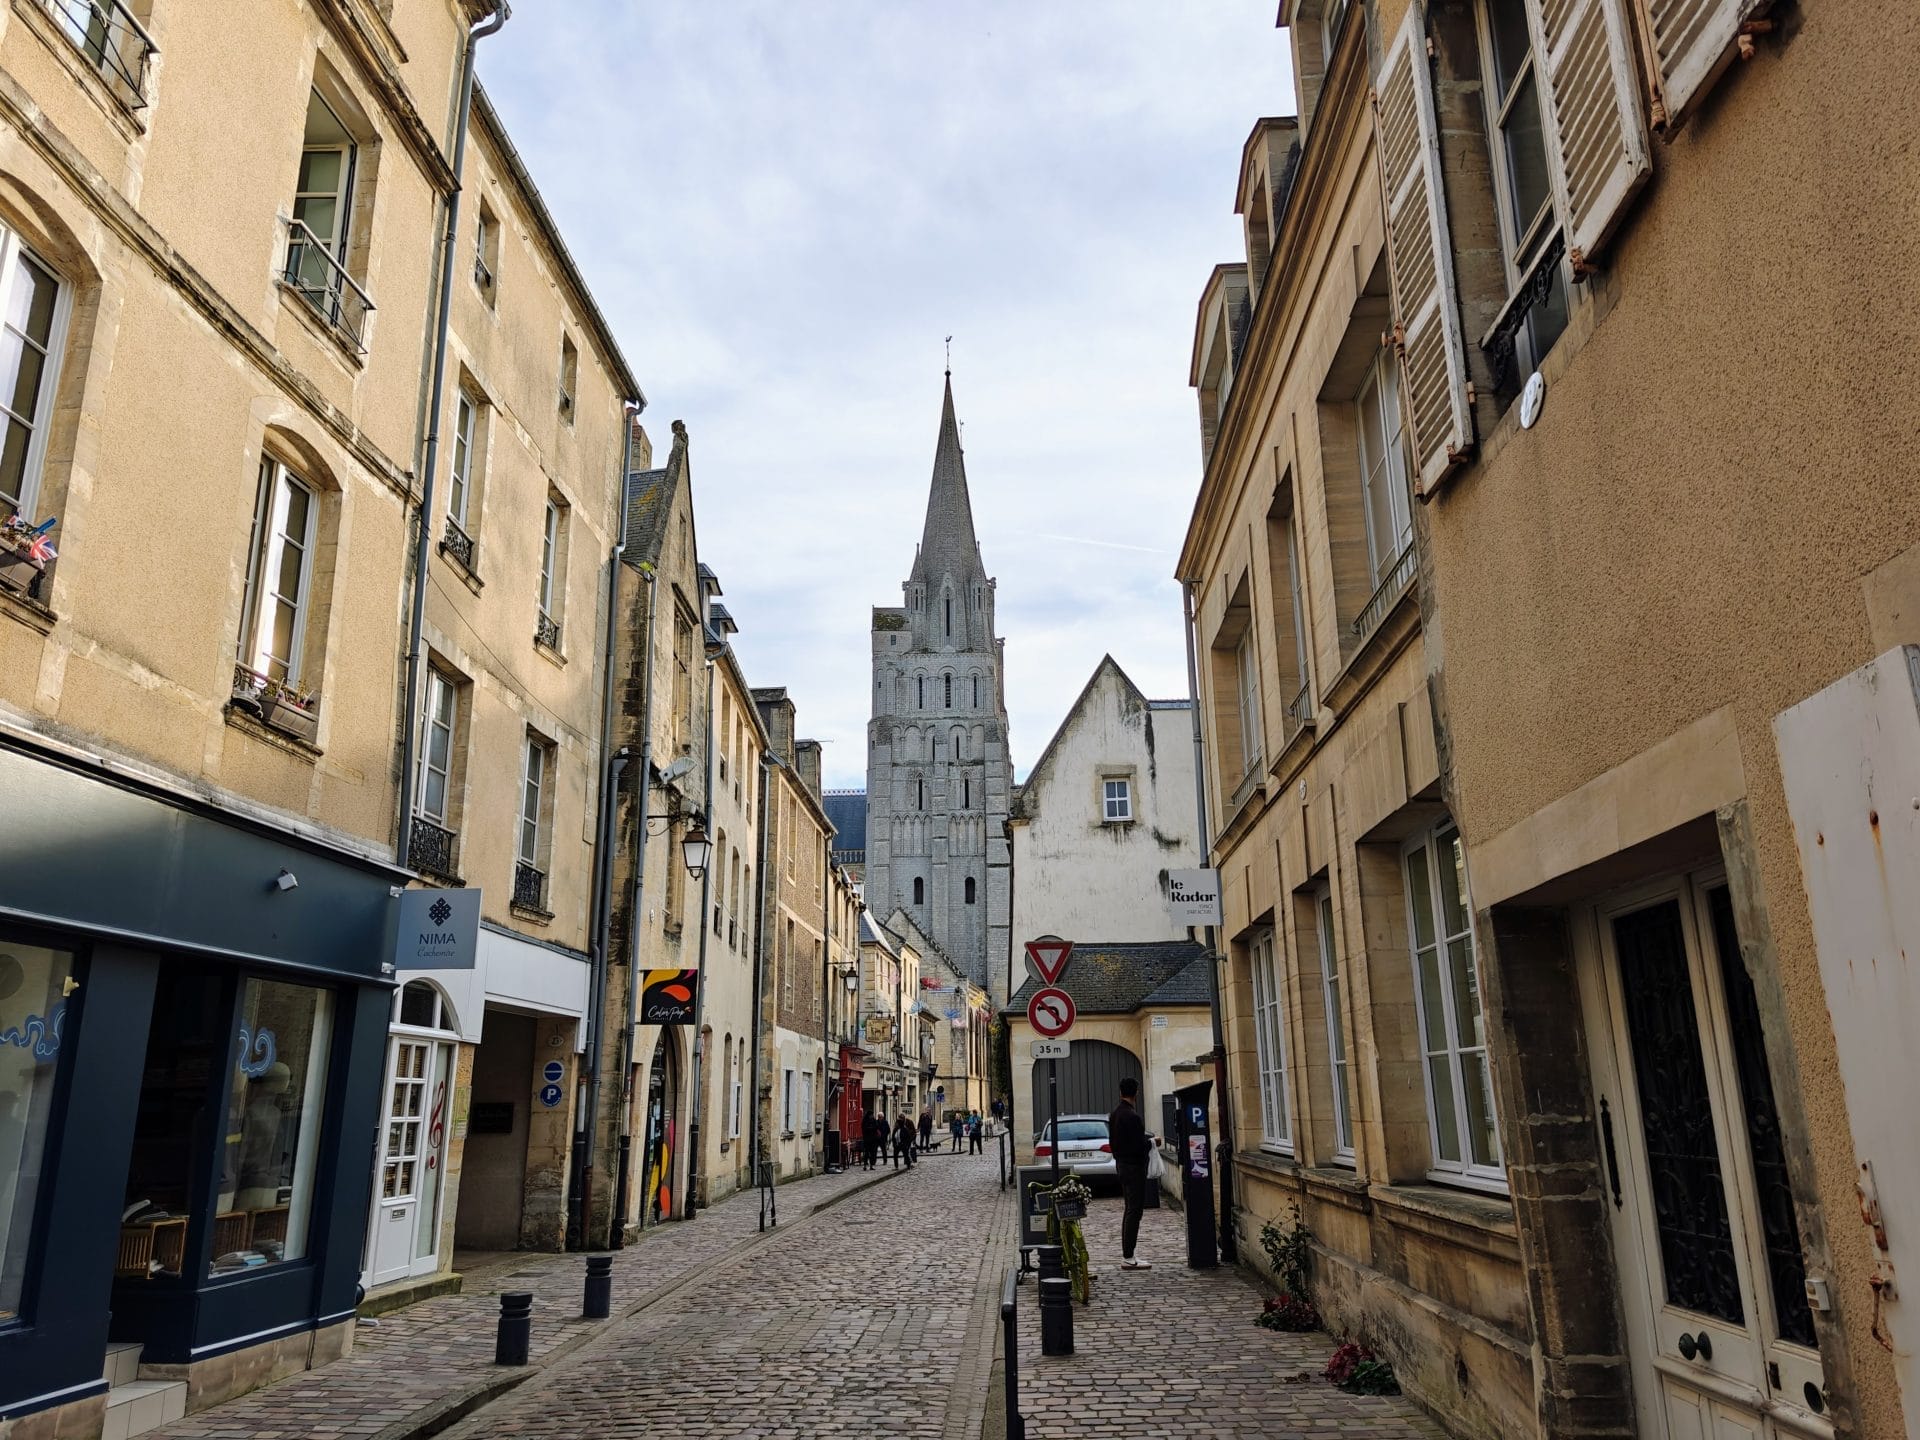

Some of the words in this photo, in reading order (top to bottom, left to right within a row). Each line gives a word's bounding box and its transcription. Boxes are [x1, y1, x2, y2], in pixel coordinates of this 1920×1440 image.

[1170, 879, 1184, 890] le
[1171, 891, 1216, 902] Radar
[419, 933, 456, 944] NIMA
[1039, 1045, 1052, 1054] 35
[546, 1088, 557, 1100] P
[1192, 1107, 1203, 1123] P
